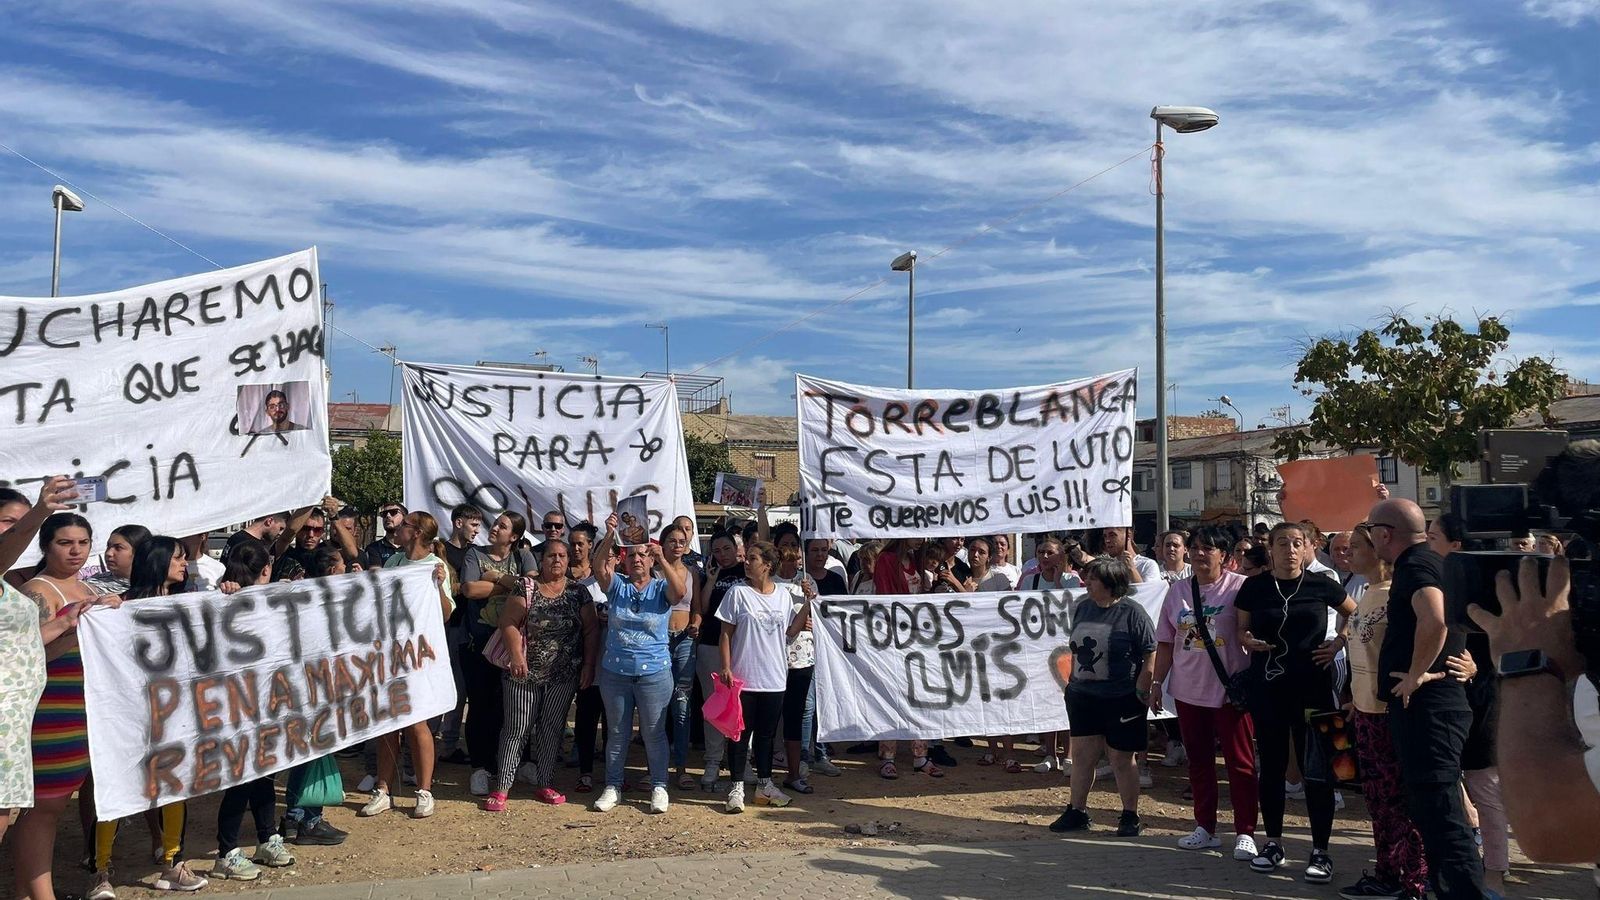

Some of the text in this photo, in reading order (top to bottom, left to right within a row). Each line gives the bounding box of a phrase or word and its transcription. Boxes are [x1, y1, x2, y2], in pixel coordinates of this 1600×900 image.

[124, 356, 201, 404] QUE
[229, 341, 267, 377] SE
[493, 430, 615, 471] PARA
[819, 425, 1133, 496] ESTA DE LUTO
[820, 588, 1090, 654] TODOS SOM
[146, 670, 293, 742] PENA
[143, 680, 412, 804] REVERCIBLE
